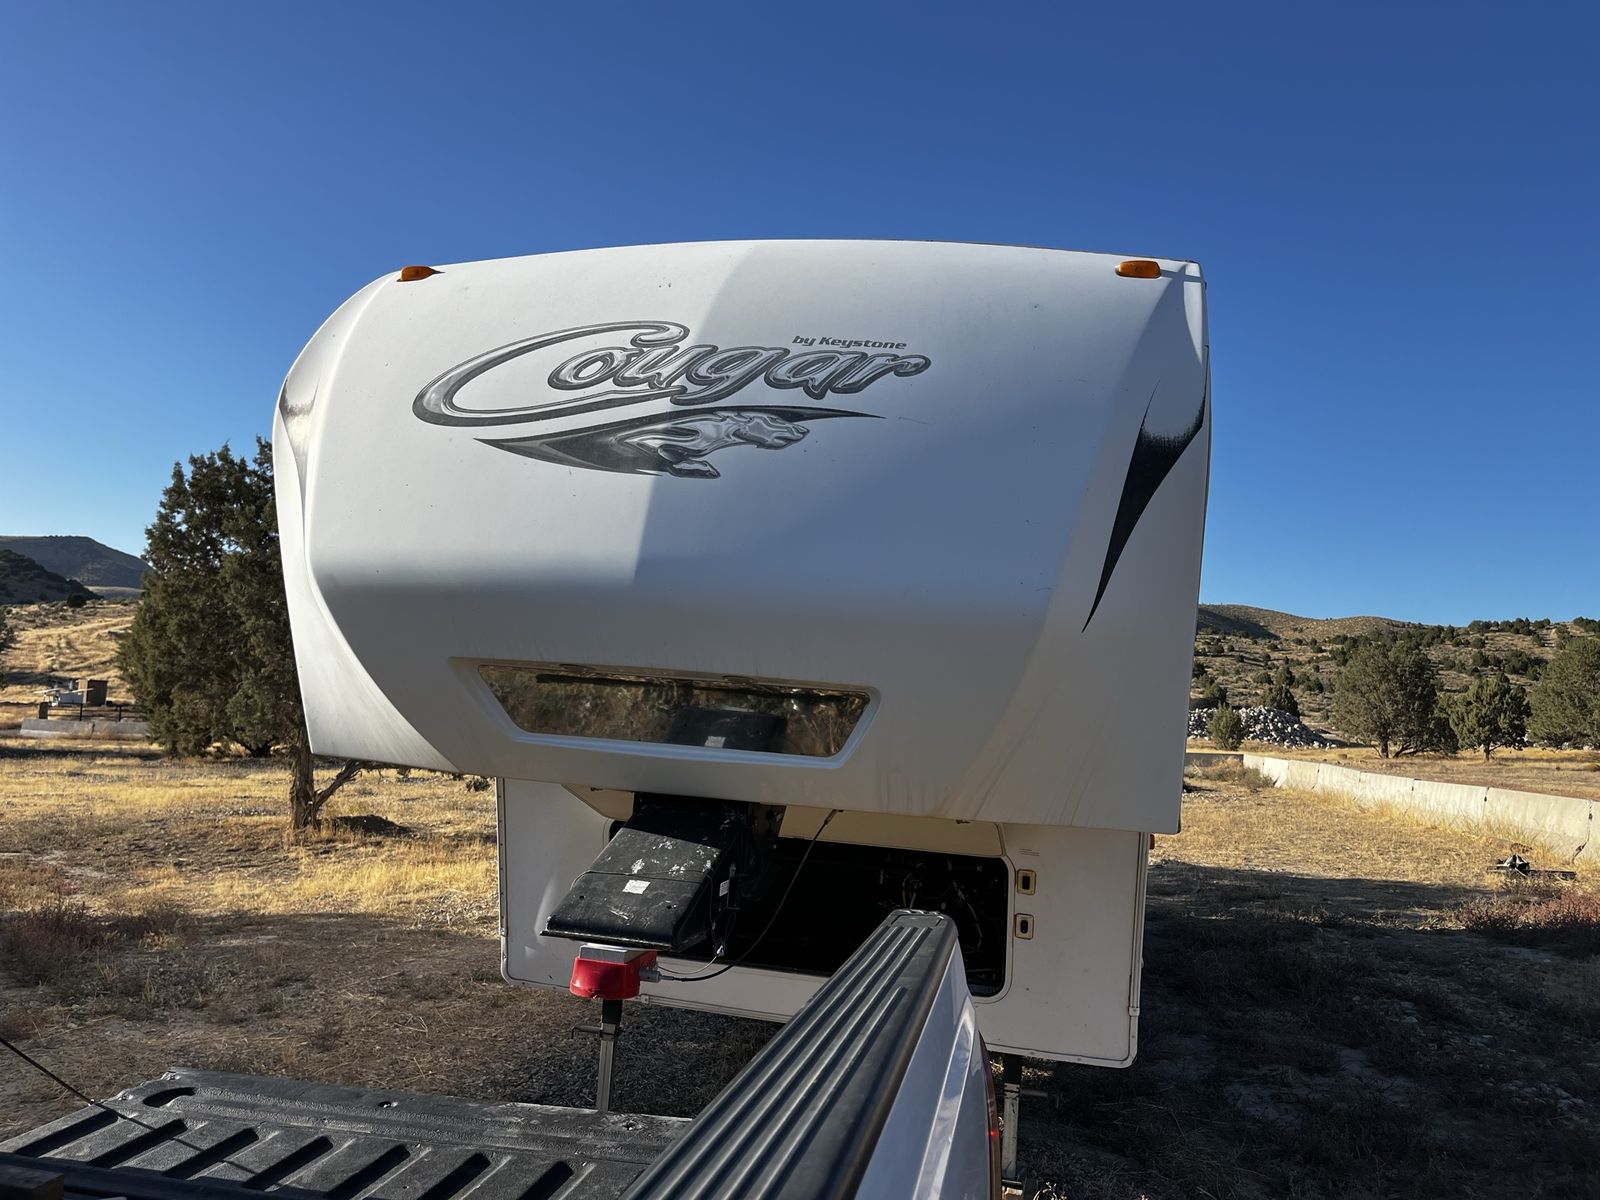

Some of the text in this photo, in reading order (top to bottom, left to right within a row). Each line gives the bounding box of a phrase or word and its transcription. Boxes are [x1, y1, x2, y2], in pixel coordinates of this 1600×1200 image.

[792, 335, 907, 350] by Keystone
[412, 320, 932, 427] Cougar
